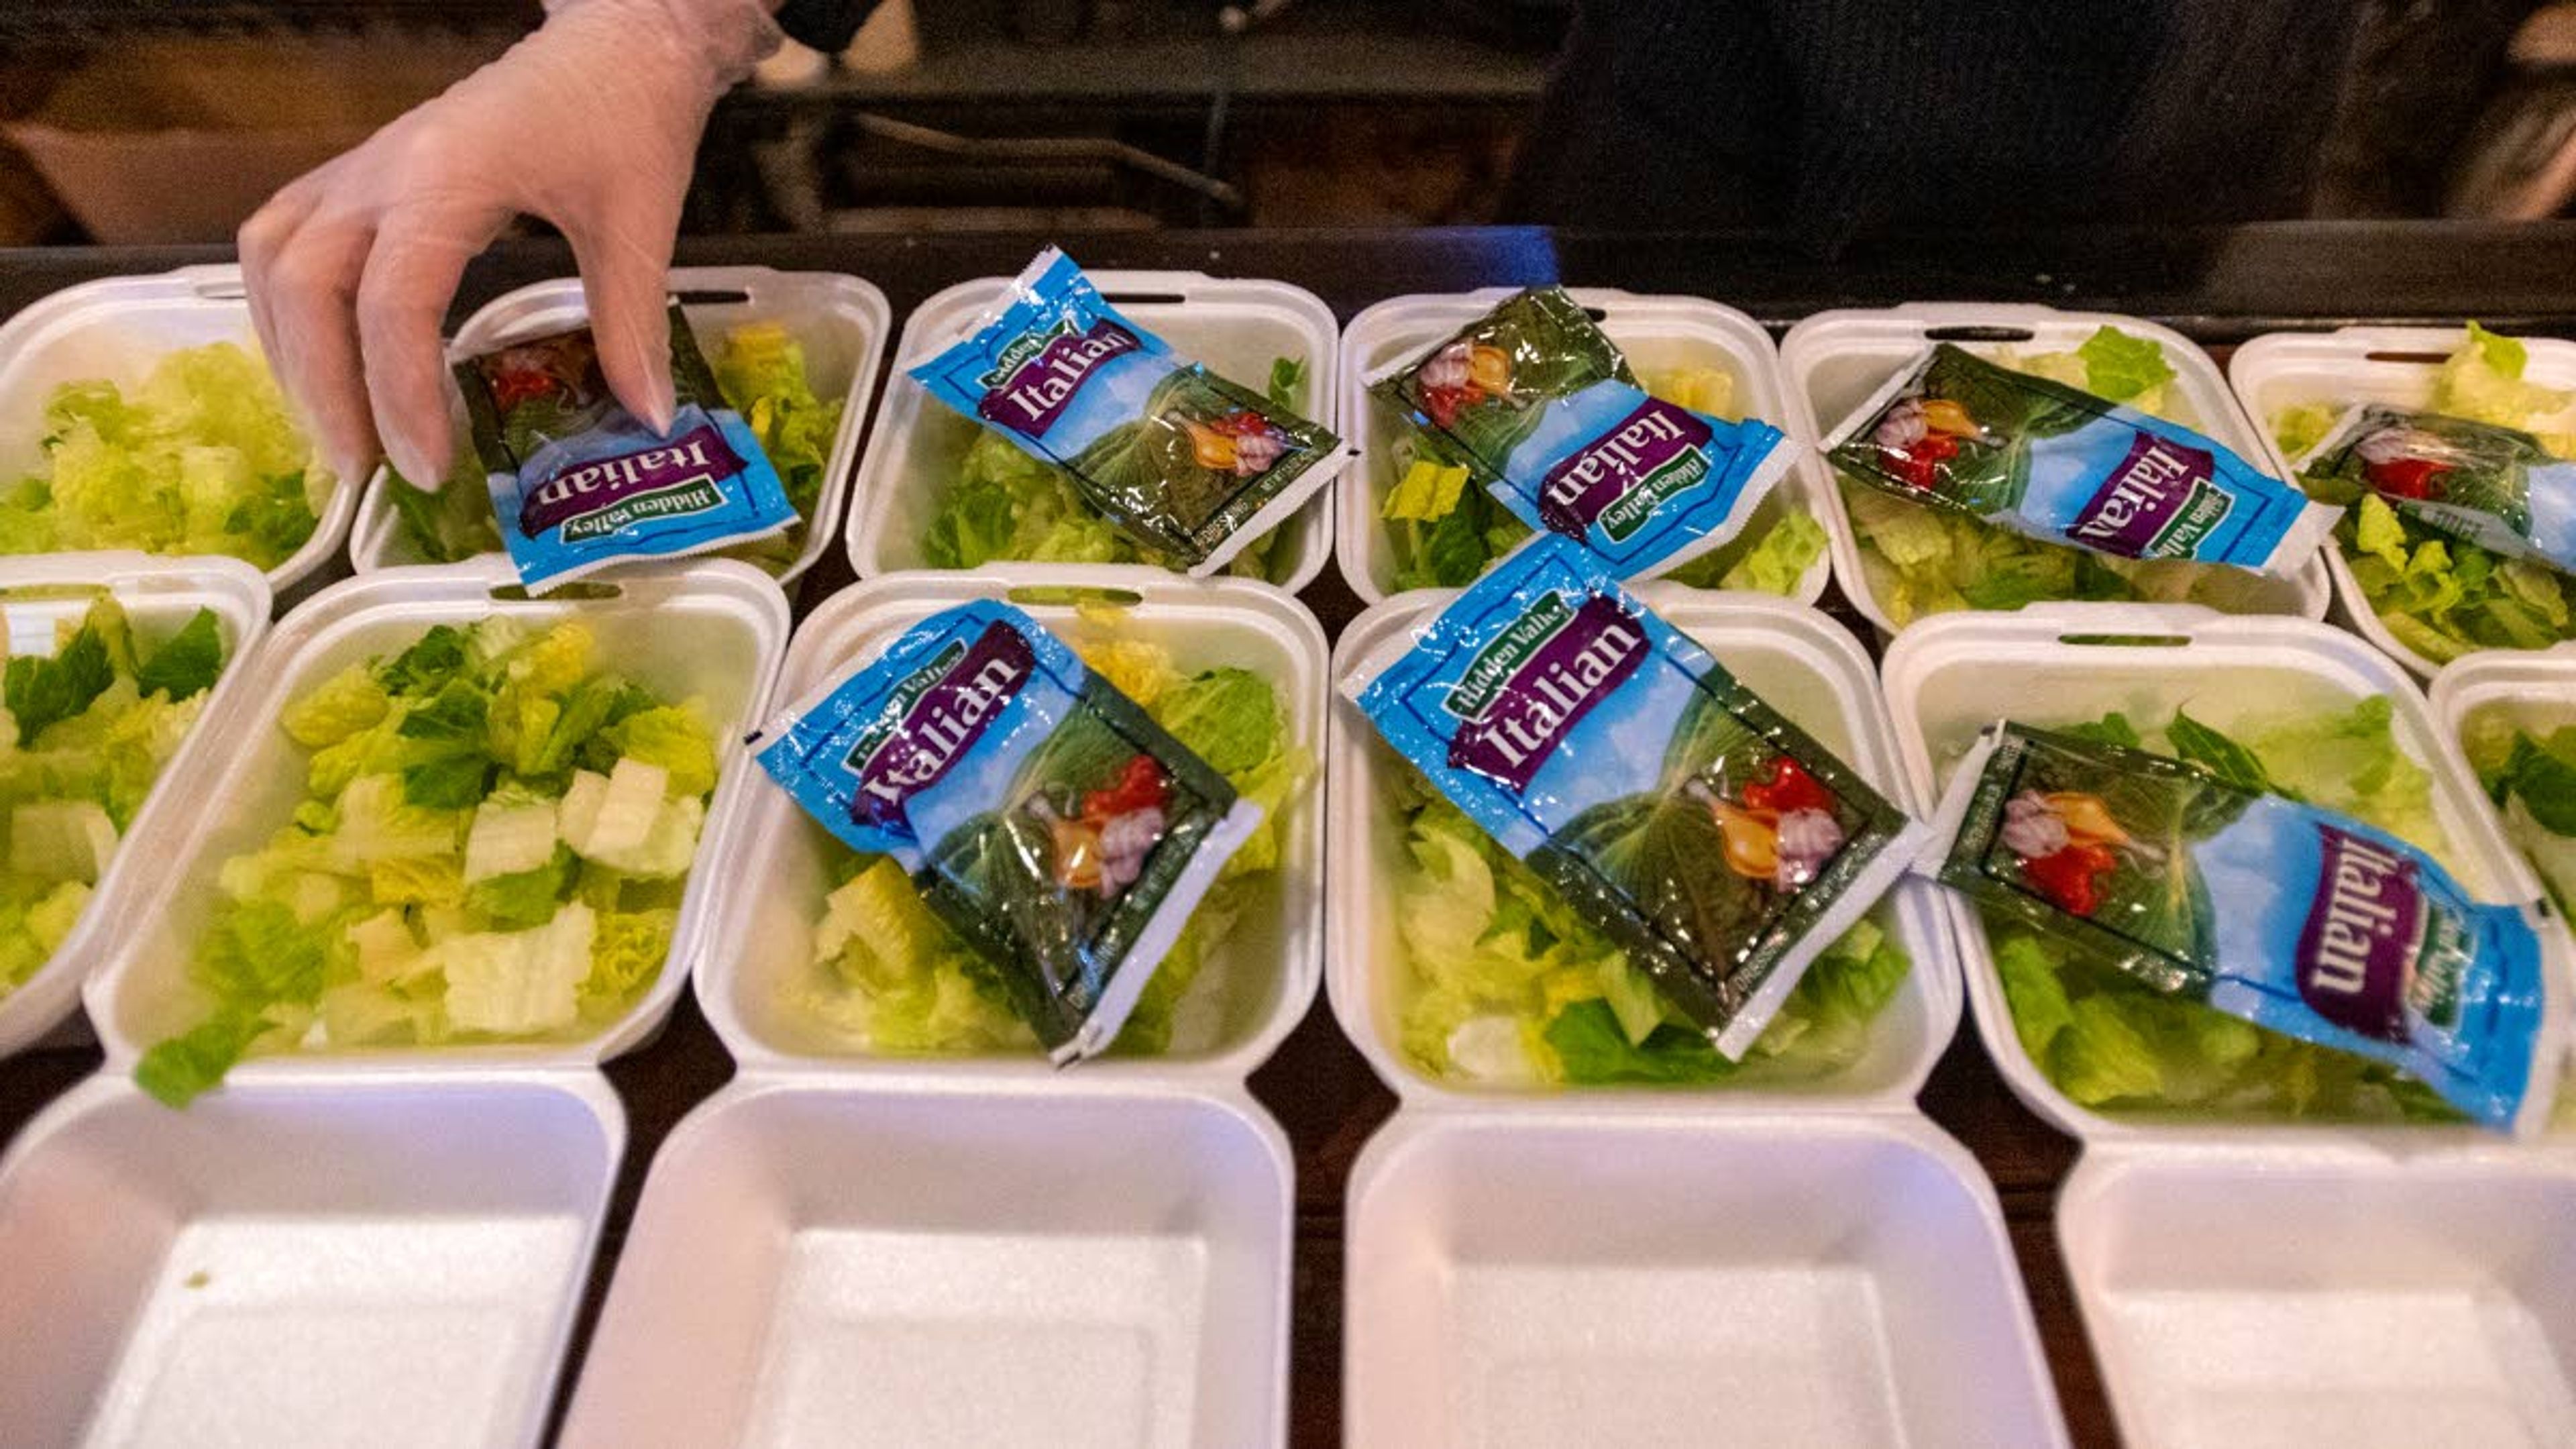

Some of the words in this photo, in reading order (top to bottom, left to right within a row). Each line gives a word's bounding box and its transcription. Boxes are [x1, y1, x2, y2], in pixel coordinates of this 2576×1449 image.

[1007, 331, 1130, 422] Italian
[538, 439, 712, 504] Italian
[632, 488, 711, 515] Hidden
[1546, 410, 1686, 506] Italian
[2078, 446, 2190, 537] Italian
[1455, 637, 1520, 709] Hidden
[1481, 623, 1642, 769] Italian
[863, 657, 1020, 806] Italian
[2311, 839, 2400, 993] Italian
